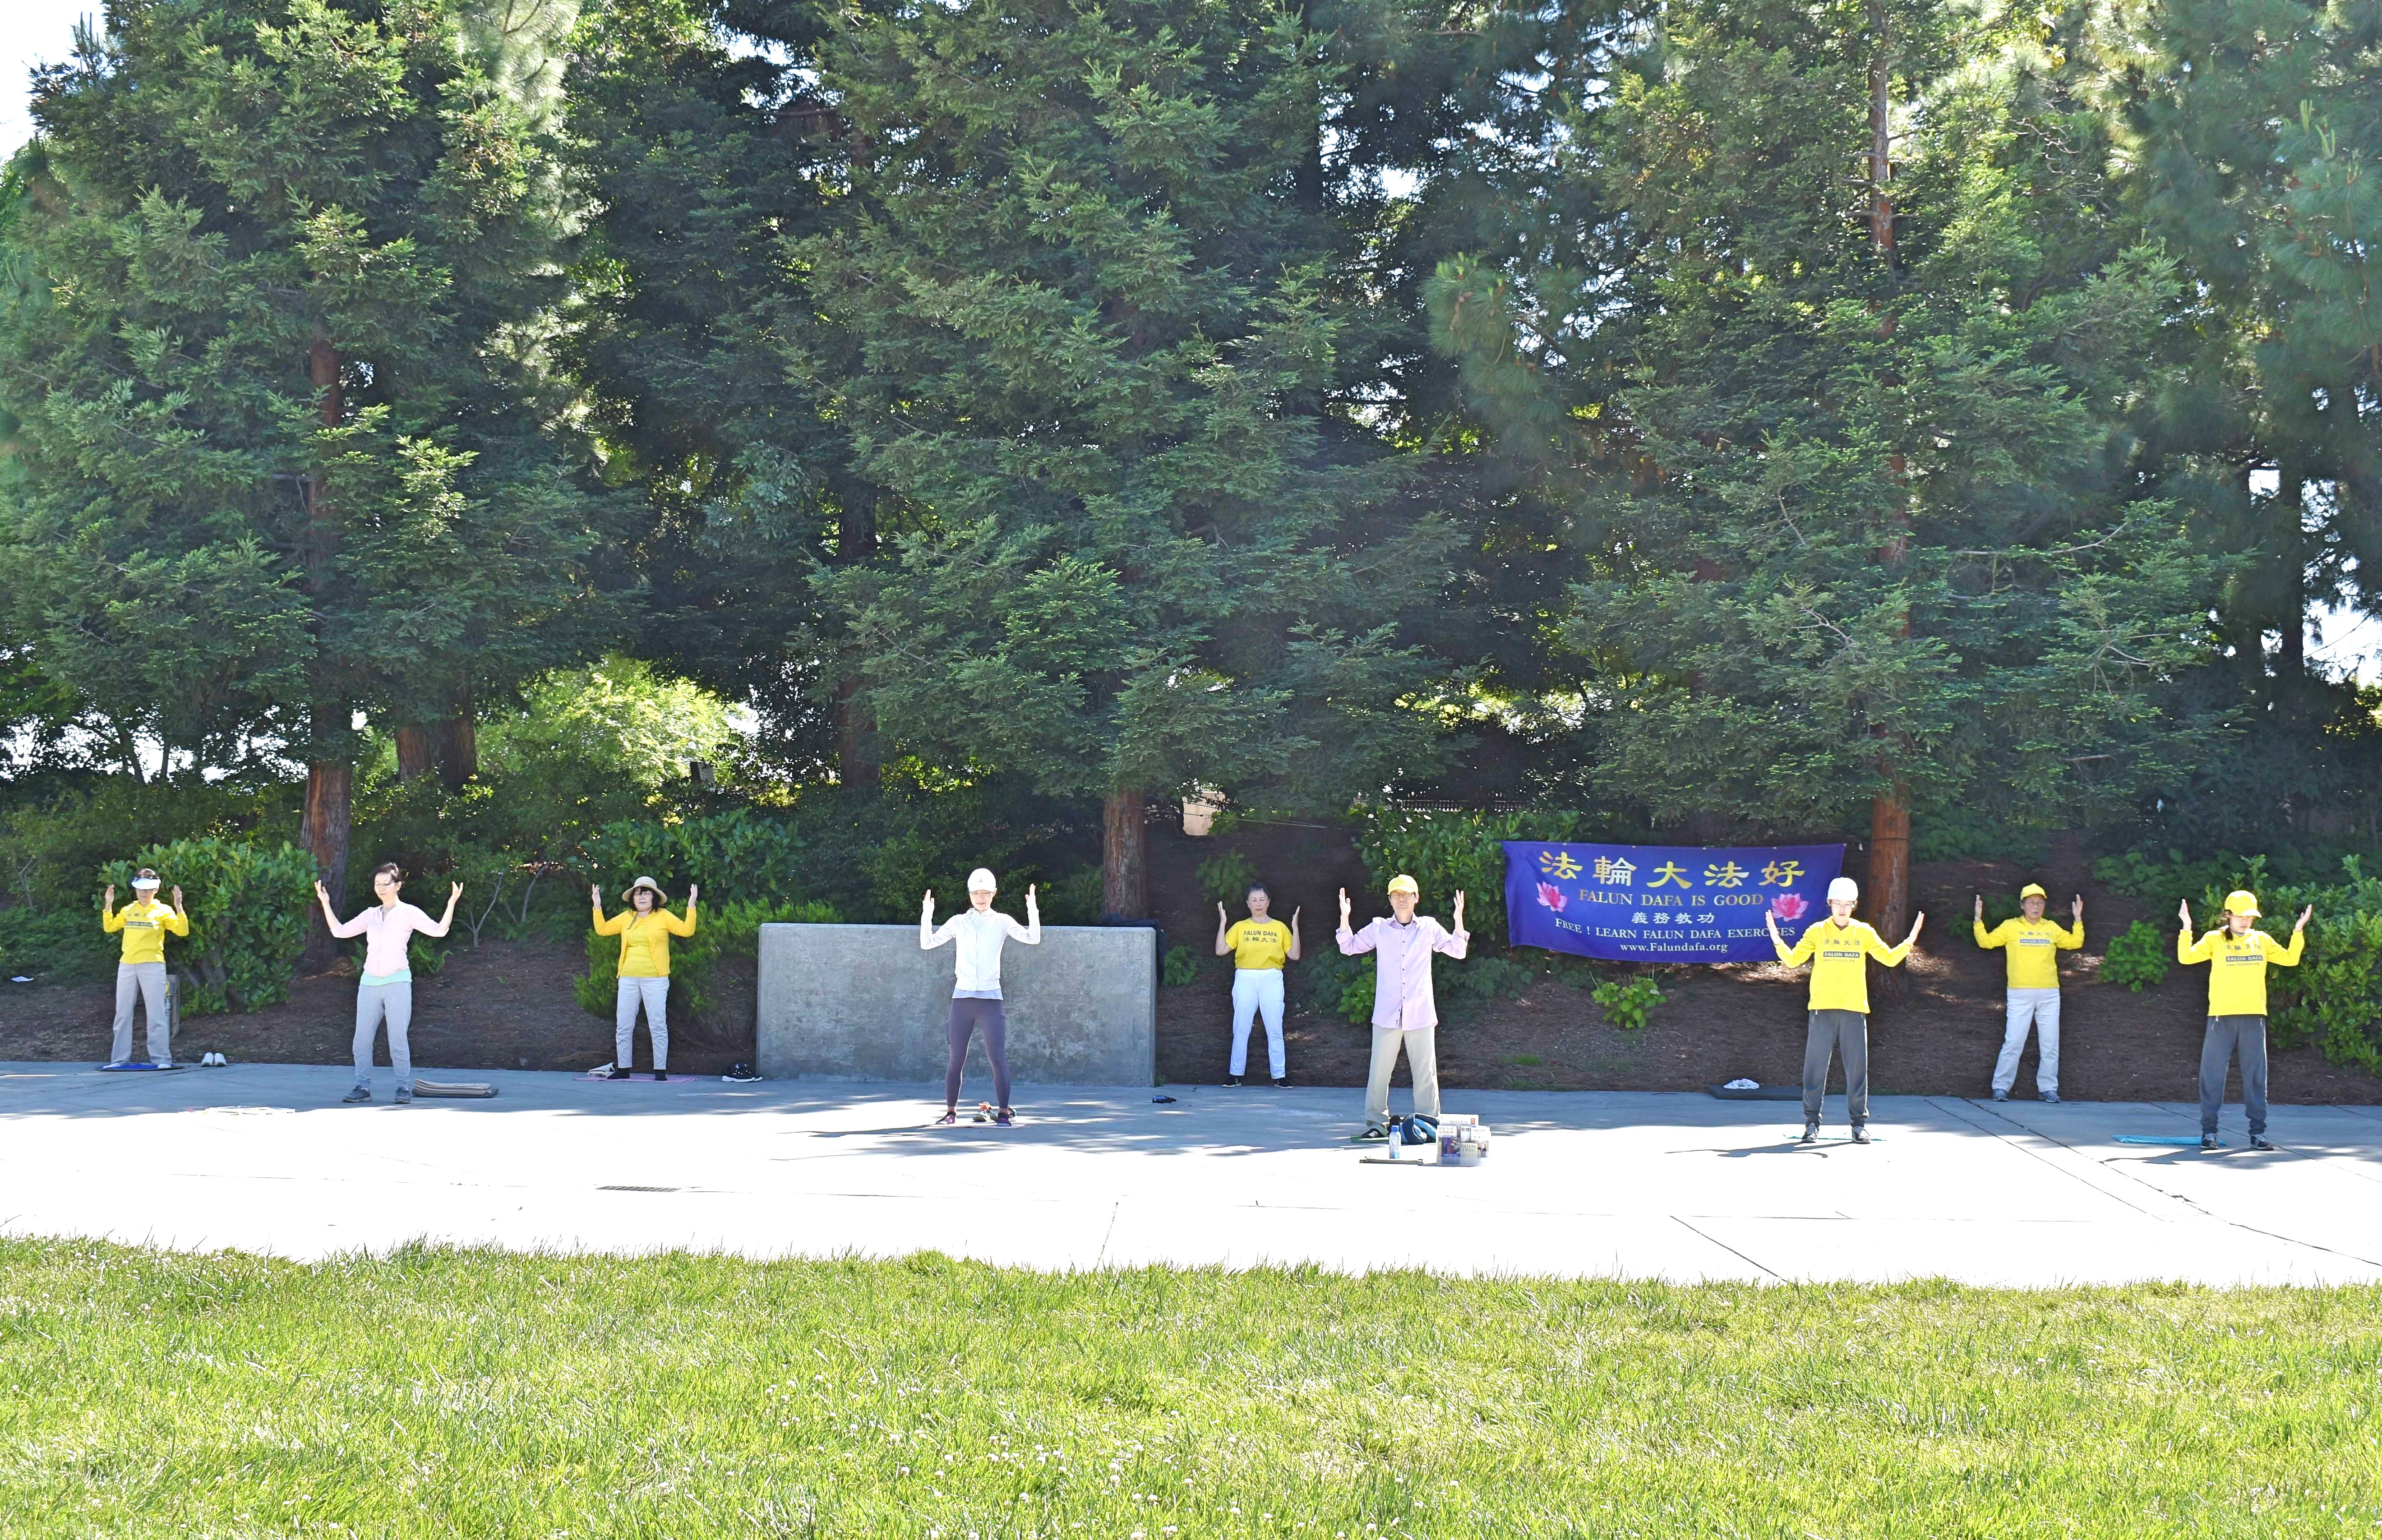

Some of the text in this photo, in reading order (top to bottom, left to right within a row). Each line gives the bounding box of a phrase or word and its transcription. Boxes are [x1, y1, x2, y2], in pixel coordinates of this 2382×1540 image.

[1539, 851, 1805, 889] 法輪大法好
[1579, 889, 1763, 906] FALUN DAFA IS GOOD
[1631, 912, 1714, 924] 義務教功
[1555, 918, 1582, 933] FREE
[1595, 927, 1636, 938] LEARN
[1643, 930, 1684, 939] FALUN
[1691, 930, 1722, 938] DAFA
[1727, 927, 1795, 938] EXERCES
[1620, 943, 1728, 953] www.Falundafa.org
